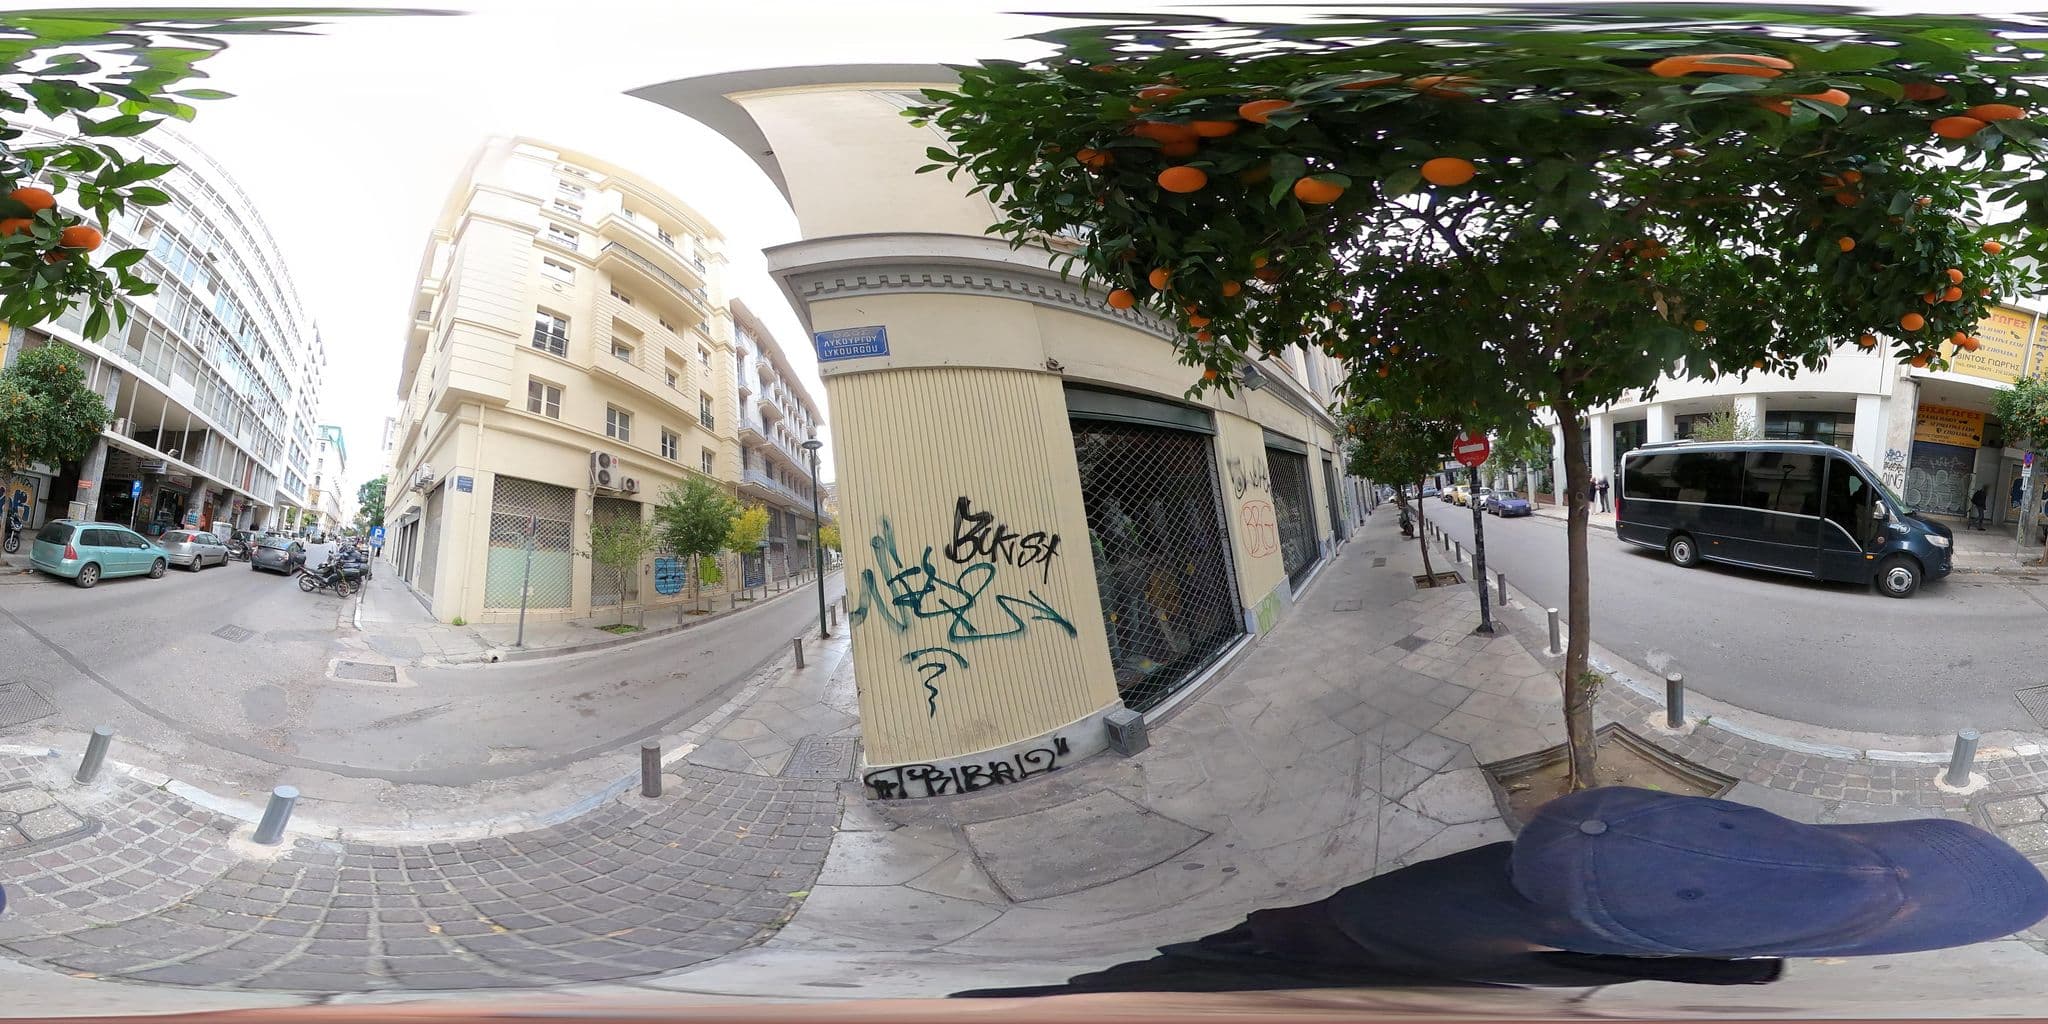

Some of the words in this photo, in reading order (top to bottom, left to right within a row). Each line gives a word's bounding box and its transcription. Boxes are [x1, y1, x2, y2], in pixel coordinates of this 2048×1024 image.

[824, 335, 877, 347] ΛΥΚΟΥΡΓΟΥ
[824, 345, 878, 357] LYKOURGOU
[374, 528, 382, 538] P
